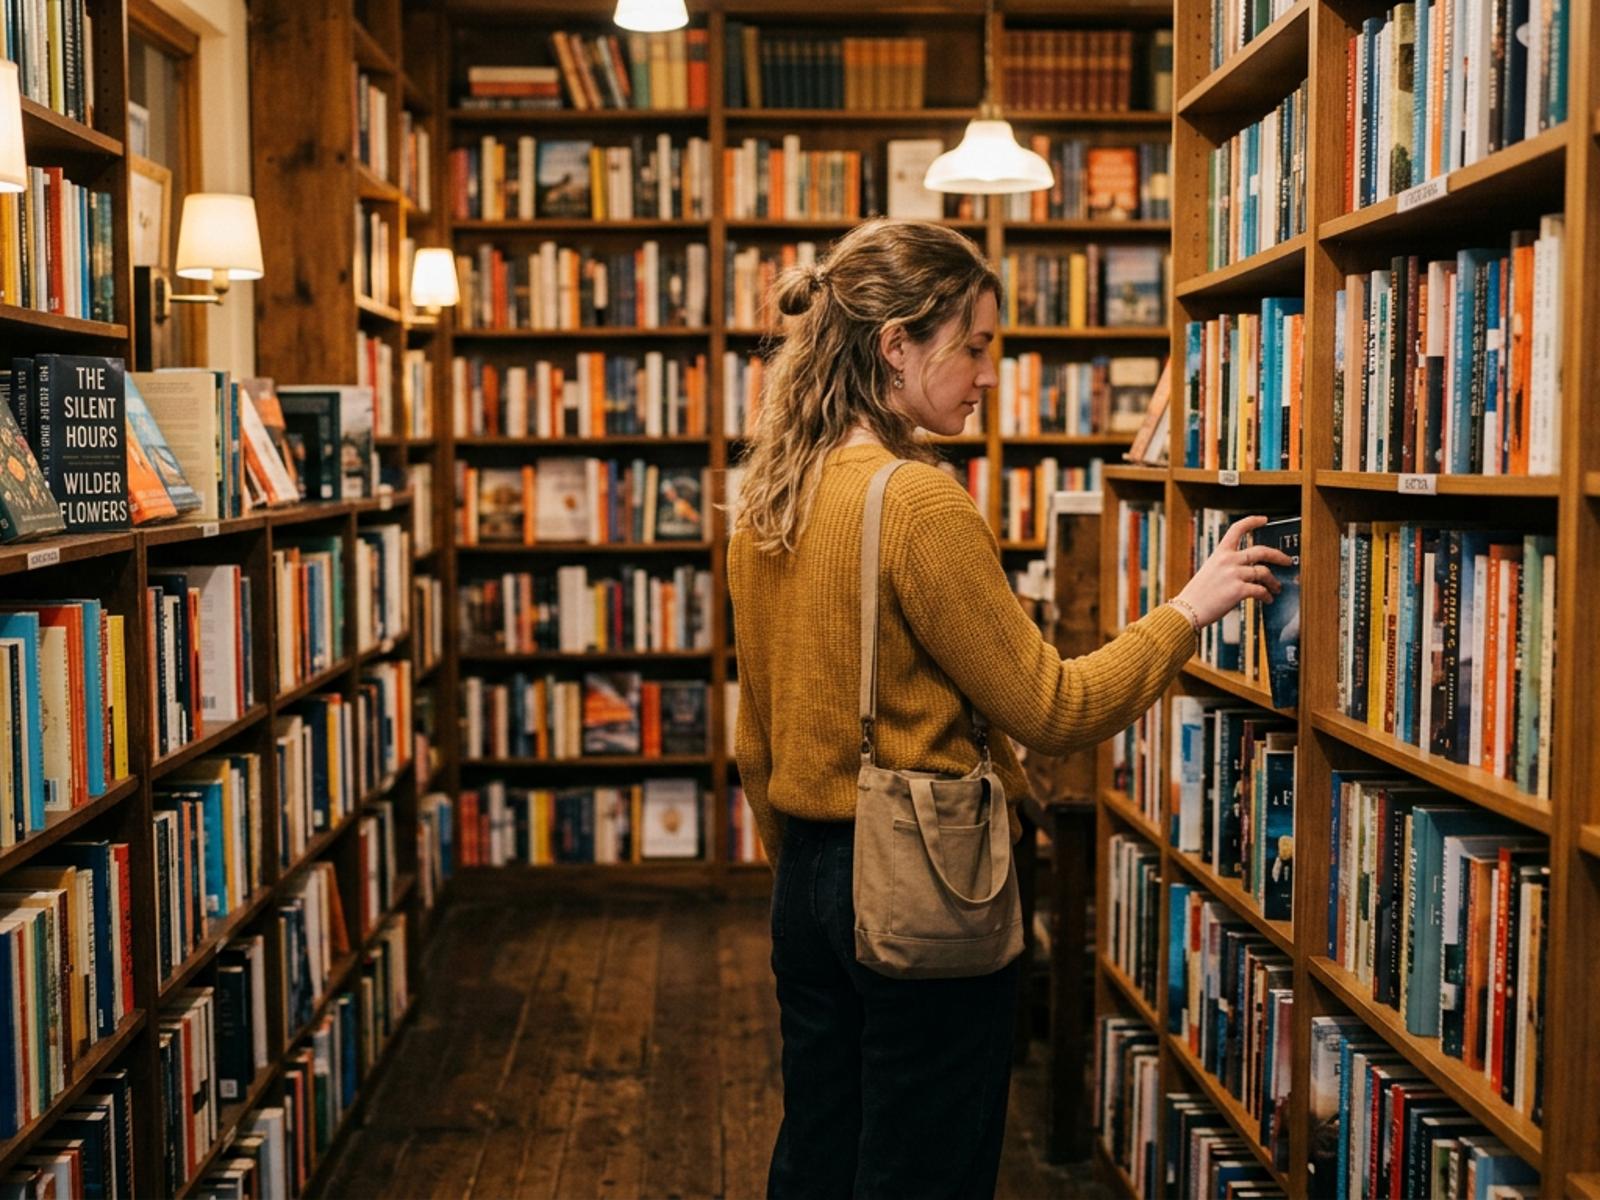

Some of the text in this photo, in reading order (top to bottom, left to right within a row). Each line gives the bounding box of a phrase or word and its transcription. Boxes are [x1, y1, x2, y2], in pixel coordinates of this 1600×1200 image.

[76, 367, 106, 390] THE
[64, 396, 117, 419] SILENT
[66, 425, 118, 448] HOURS
[63, 472, 121, 495] WILDER
[59, 500, 128, 524] FLOWERS
